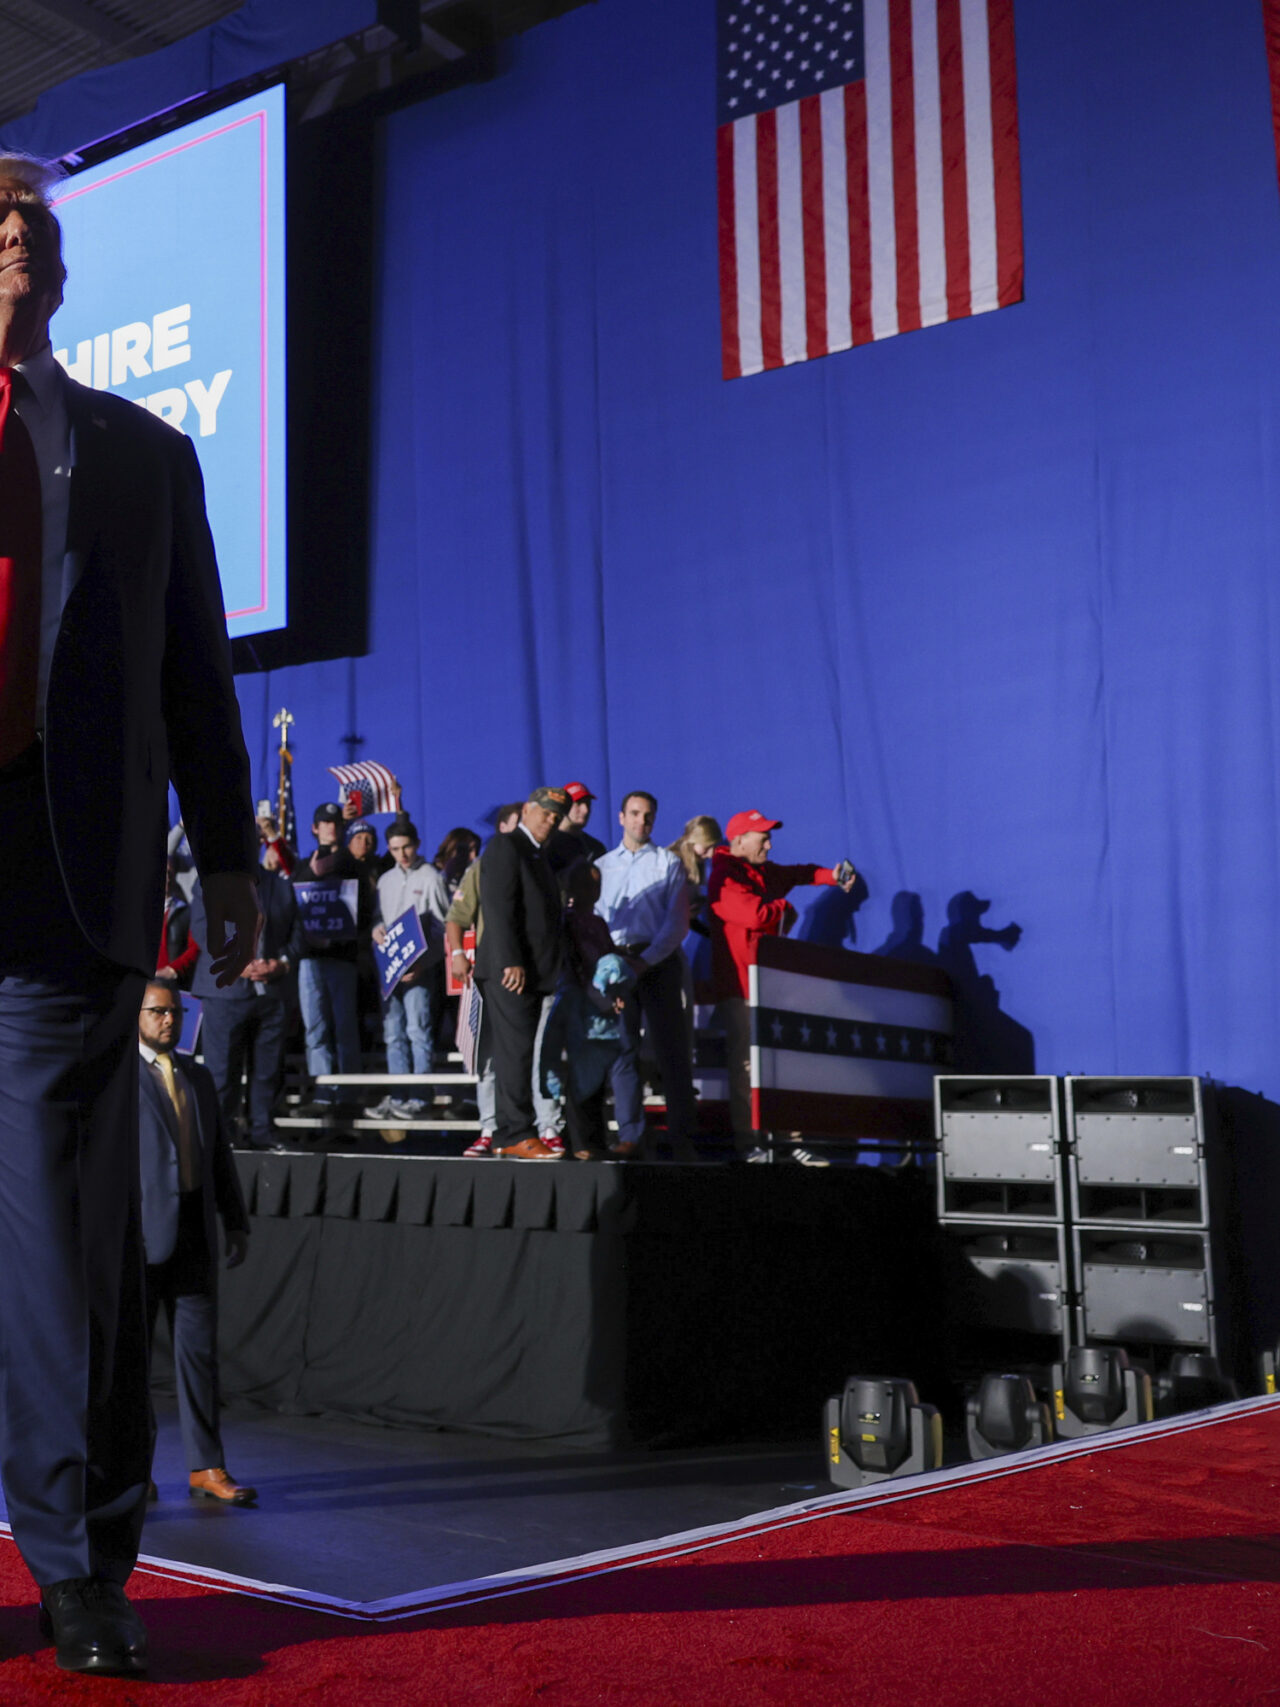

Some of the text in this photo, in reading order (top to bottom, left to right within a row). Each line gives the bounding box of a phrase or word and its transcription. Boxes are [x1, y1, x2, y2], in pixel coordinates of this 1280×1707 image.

[301, 890, 338, 904] VOTE
[327, 917, 344, 931] 23
[401, 940, 416, 961] 23
